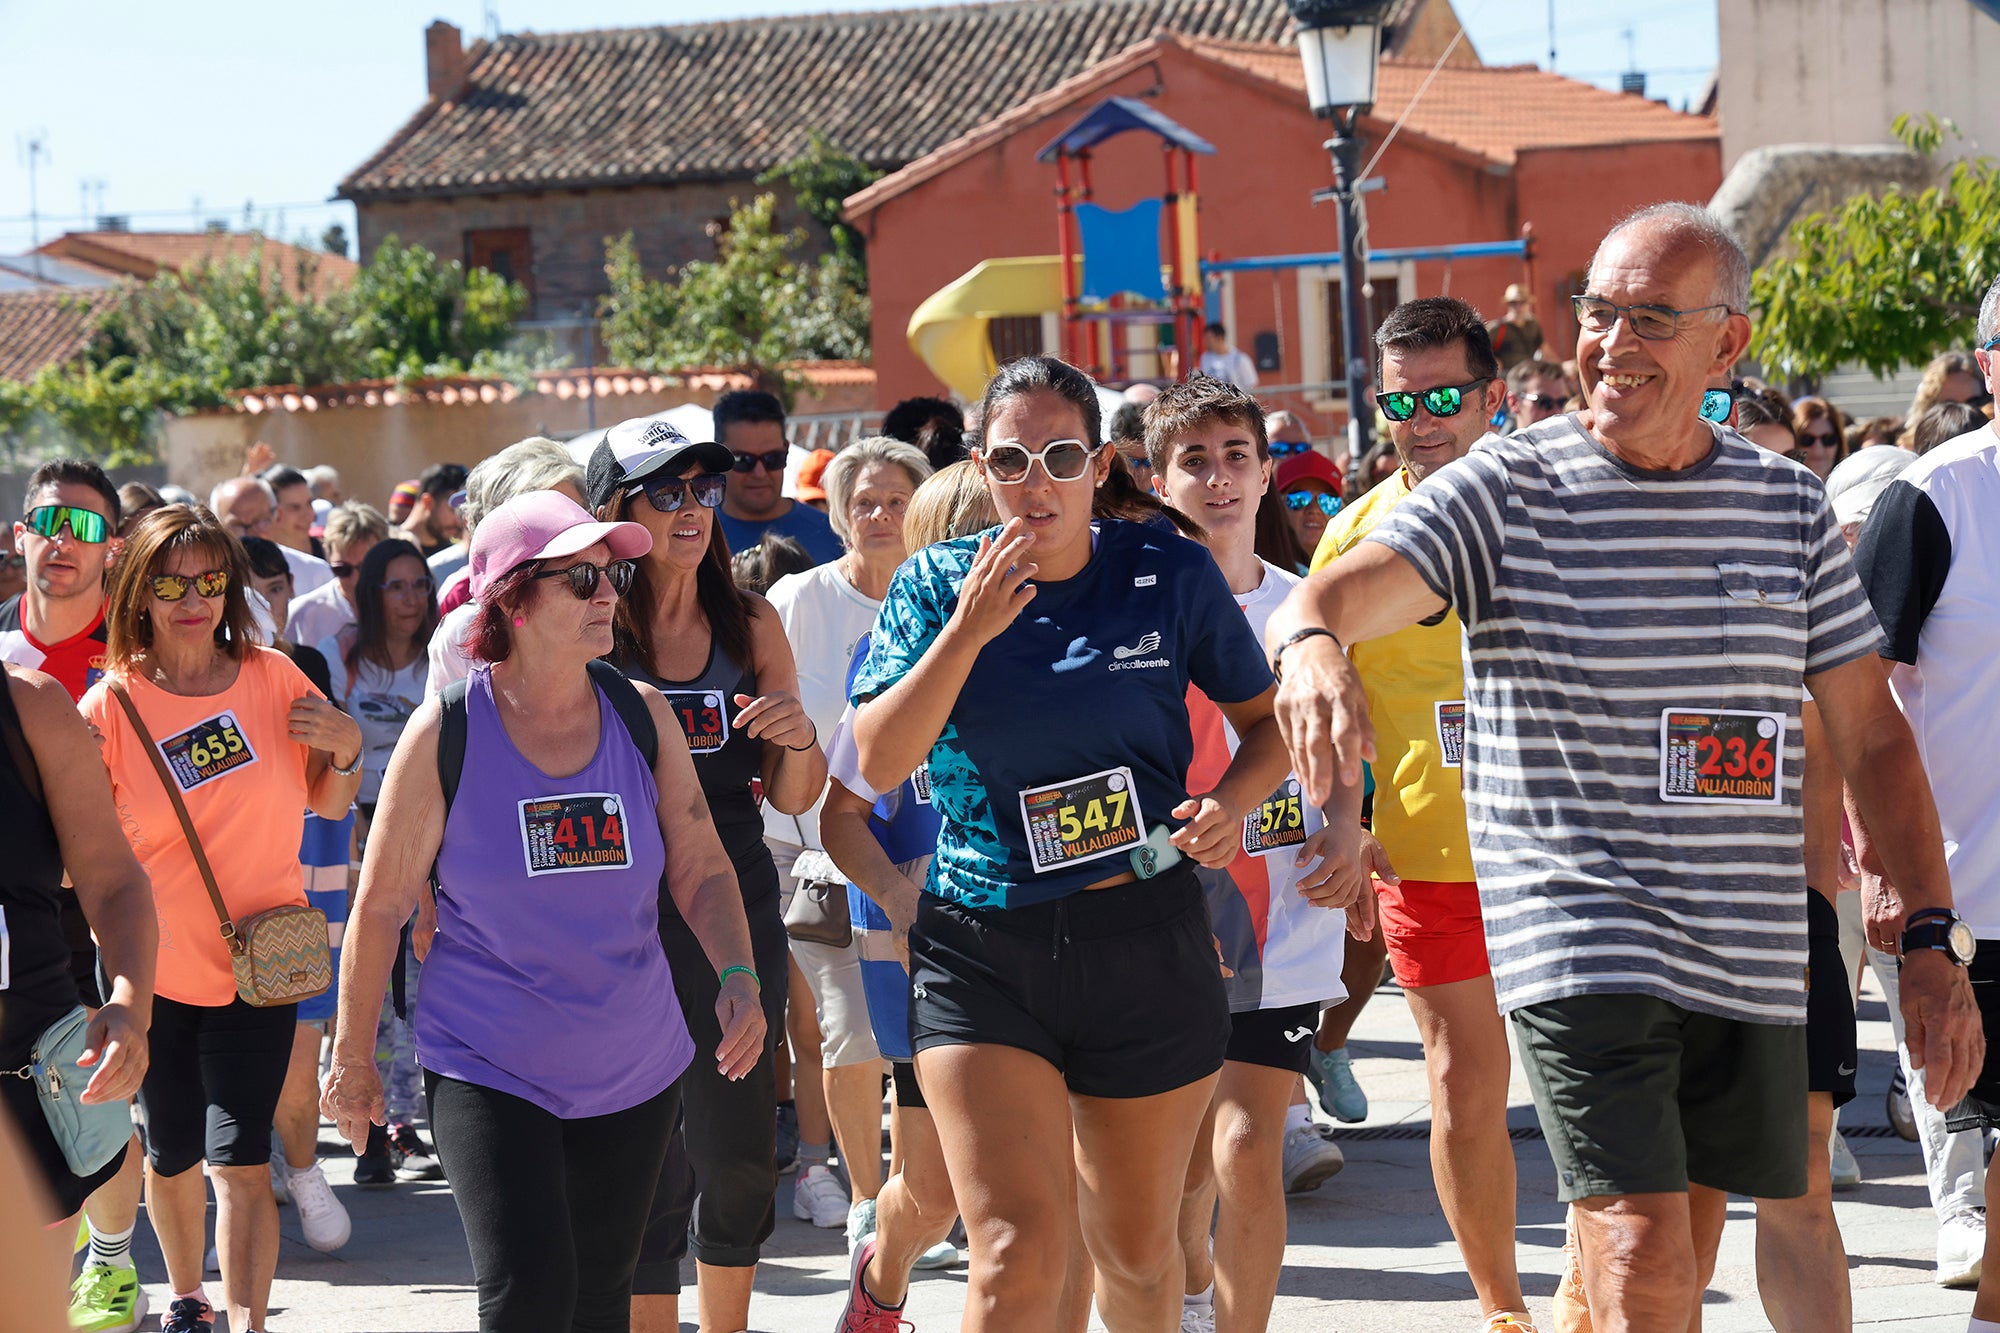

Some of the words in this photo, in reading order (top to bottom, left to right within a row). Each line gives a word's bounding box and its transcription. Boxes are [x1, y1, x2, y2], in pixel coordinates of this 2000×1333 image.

[682, 708, 721, 733] 13
[191, 727, 243, 767] 655
[688, 733, 722, 747] LOBÓN
[1677, 745, 1686, 755] de
[198, 749, 251, 778] VILLALOBÓN
[1697, 735, 1774, 778] 236
[1686, 769, 1697, 793] Fatiga
[1696, 777, 1772, 796] VILLALOBÓN
[1040, 821, 1048, 830] de
[1059, 790, 1128, 842] 547
[1260, 796, 1301, 833] 575
[538, 828, 545, 836] de
[553, 815, 623, 848] 414
[1062, 826, 1137, 857] VILLALOBÓN
[1260, 828, 1305, 847] VILLALOBÓN
[548, 846, 557, 866] Fatiga
[556, 846, 625, 865] VILLALOBÓN
[1053, 840, 1064, 860] Fatiga
